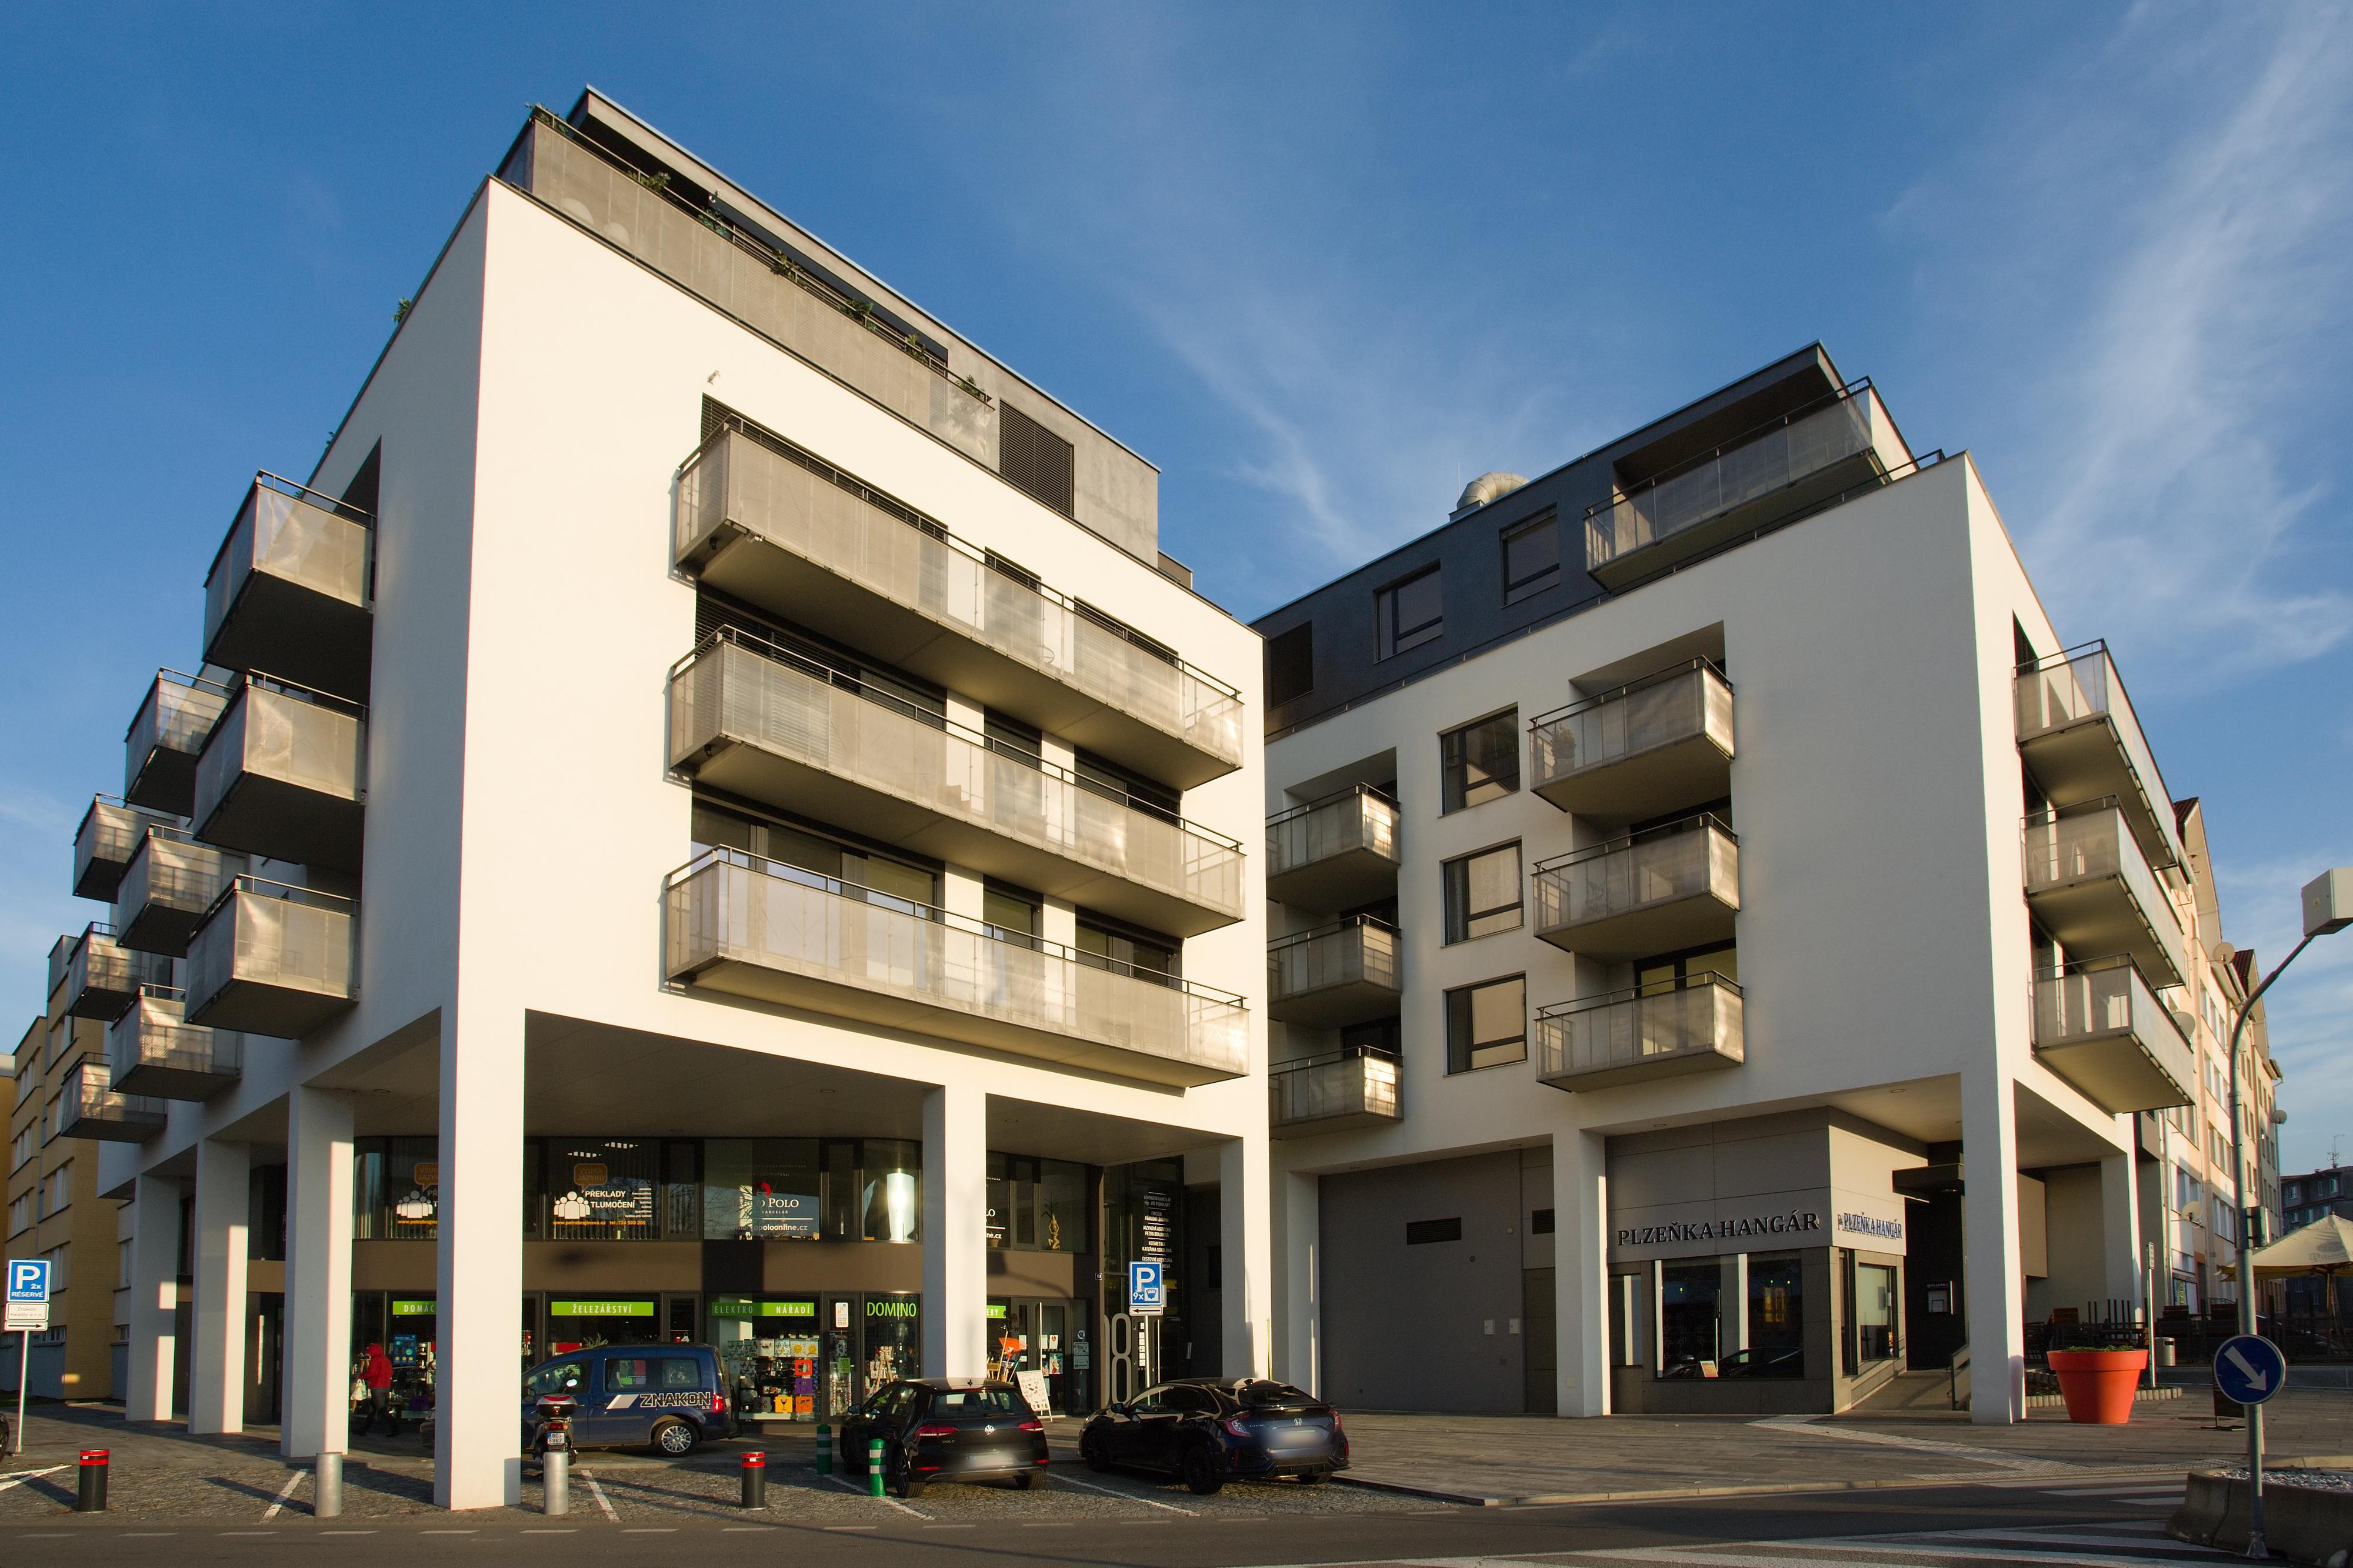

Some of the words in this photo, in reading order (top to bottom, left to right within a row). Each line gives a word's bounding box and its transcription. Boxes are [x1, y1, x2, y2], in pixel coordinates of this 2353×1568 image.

[585, 1189, 626, 1197] PŘEKLADY
[590, 1199, 635, 1208] TLUMOČENÍ
[1618, 1221, 1715, 1246] PLZEŇKA
[1720, 1209, 1820, 1238] HANGÁR
[1843, 1212, 1875, 1234] PLZEŇKA
[1875, 1219, 1902, 1239] HANGÁR
[16, 1265, 41, 1289] P
[1136, 1267, 1155, 1292] P
[1133, 1292, 1144, 1300] 9x
[572, 1303, 632, 1313] ŽELEZÁŘSTVÍ
[715, 1305, 754, 1313] ELEKTRO
[776, 1304, 811, 1314] NÁŘADÍ
[866, 1302, 916, 1317] DOMINO
[640, 1392, 711, 1408] ZNAKON
